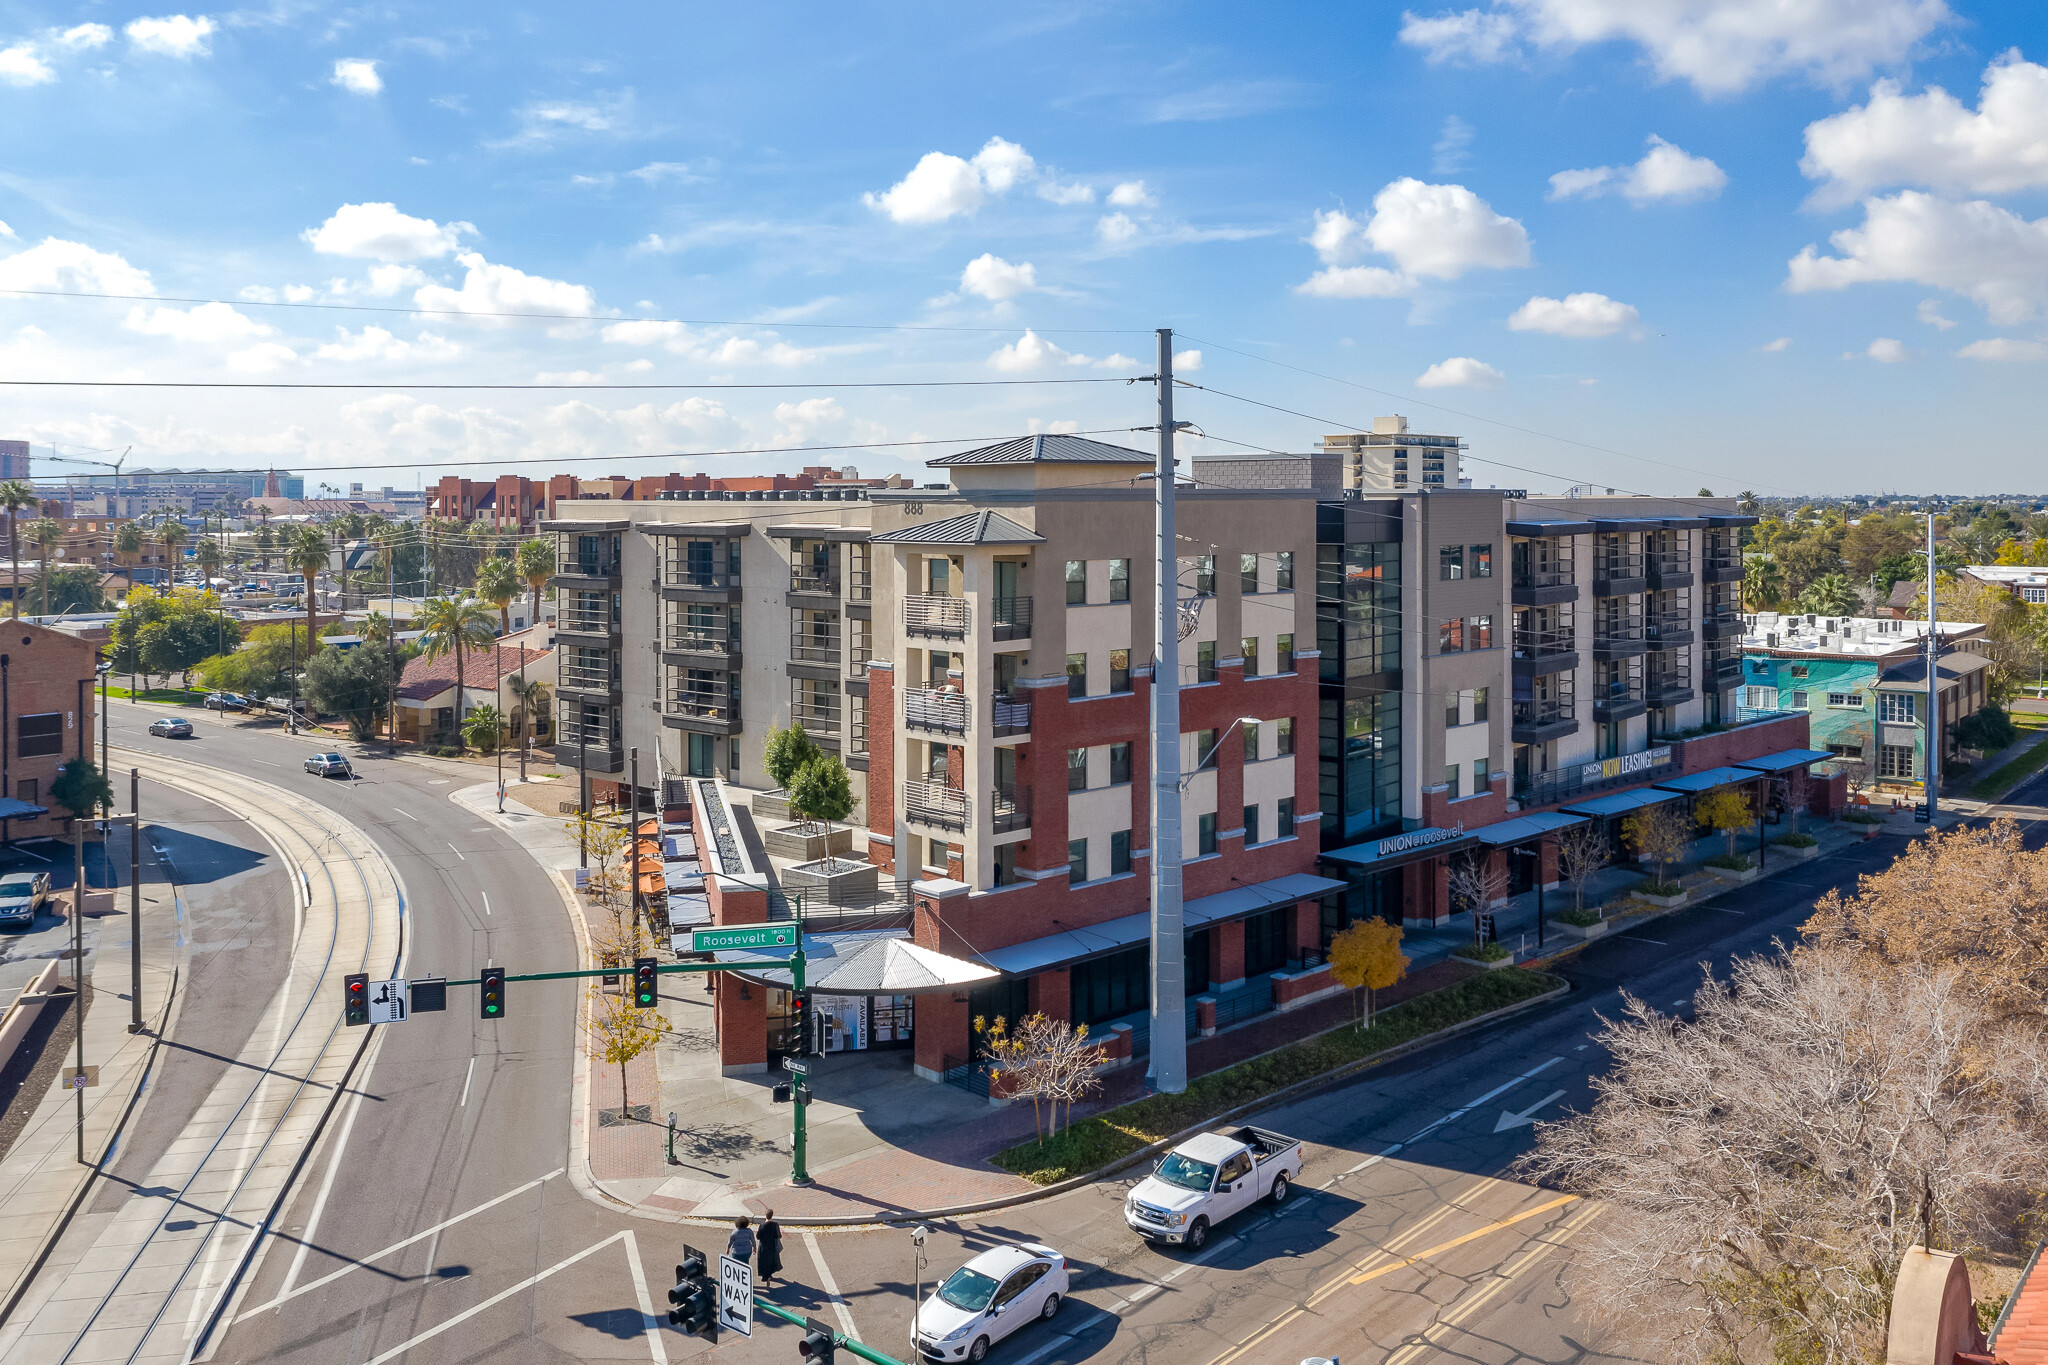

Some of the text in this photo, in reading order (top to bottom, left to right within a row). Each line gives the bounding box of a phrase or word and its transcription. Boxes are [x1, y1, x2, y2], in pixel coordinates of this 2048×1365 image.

[904, 501, 924, 515] 888
[1583, 763, 1602, 775] UNION
[1602, 757, 1621, 778] NOW
[1621, 751, 1652, 774] LEASING!
[703, 932, 766, 947] Roosevelt
[724, 1264, 748, 1287] ONE
[724, 1283, 749, 1306] WAY
